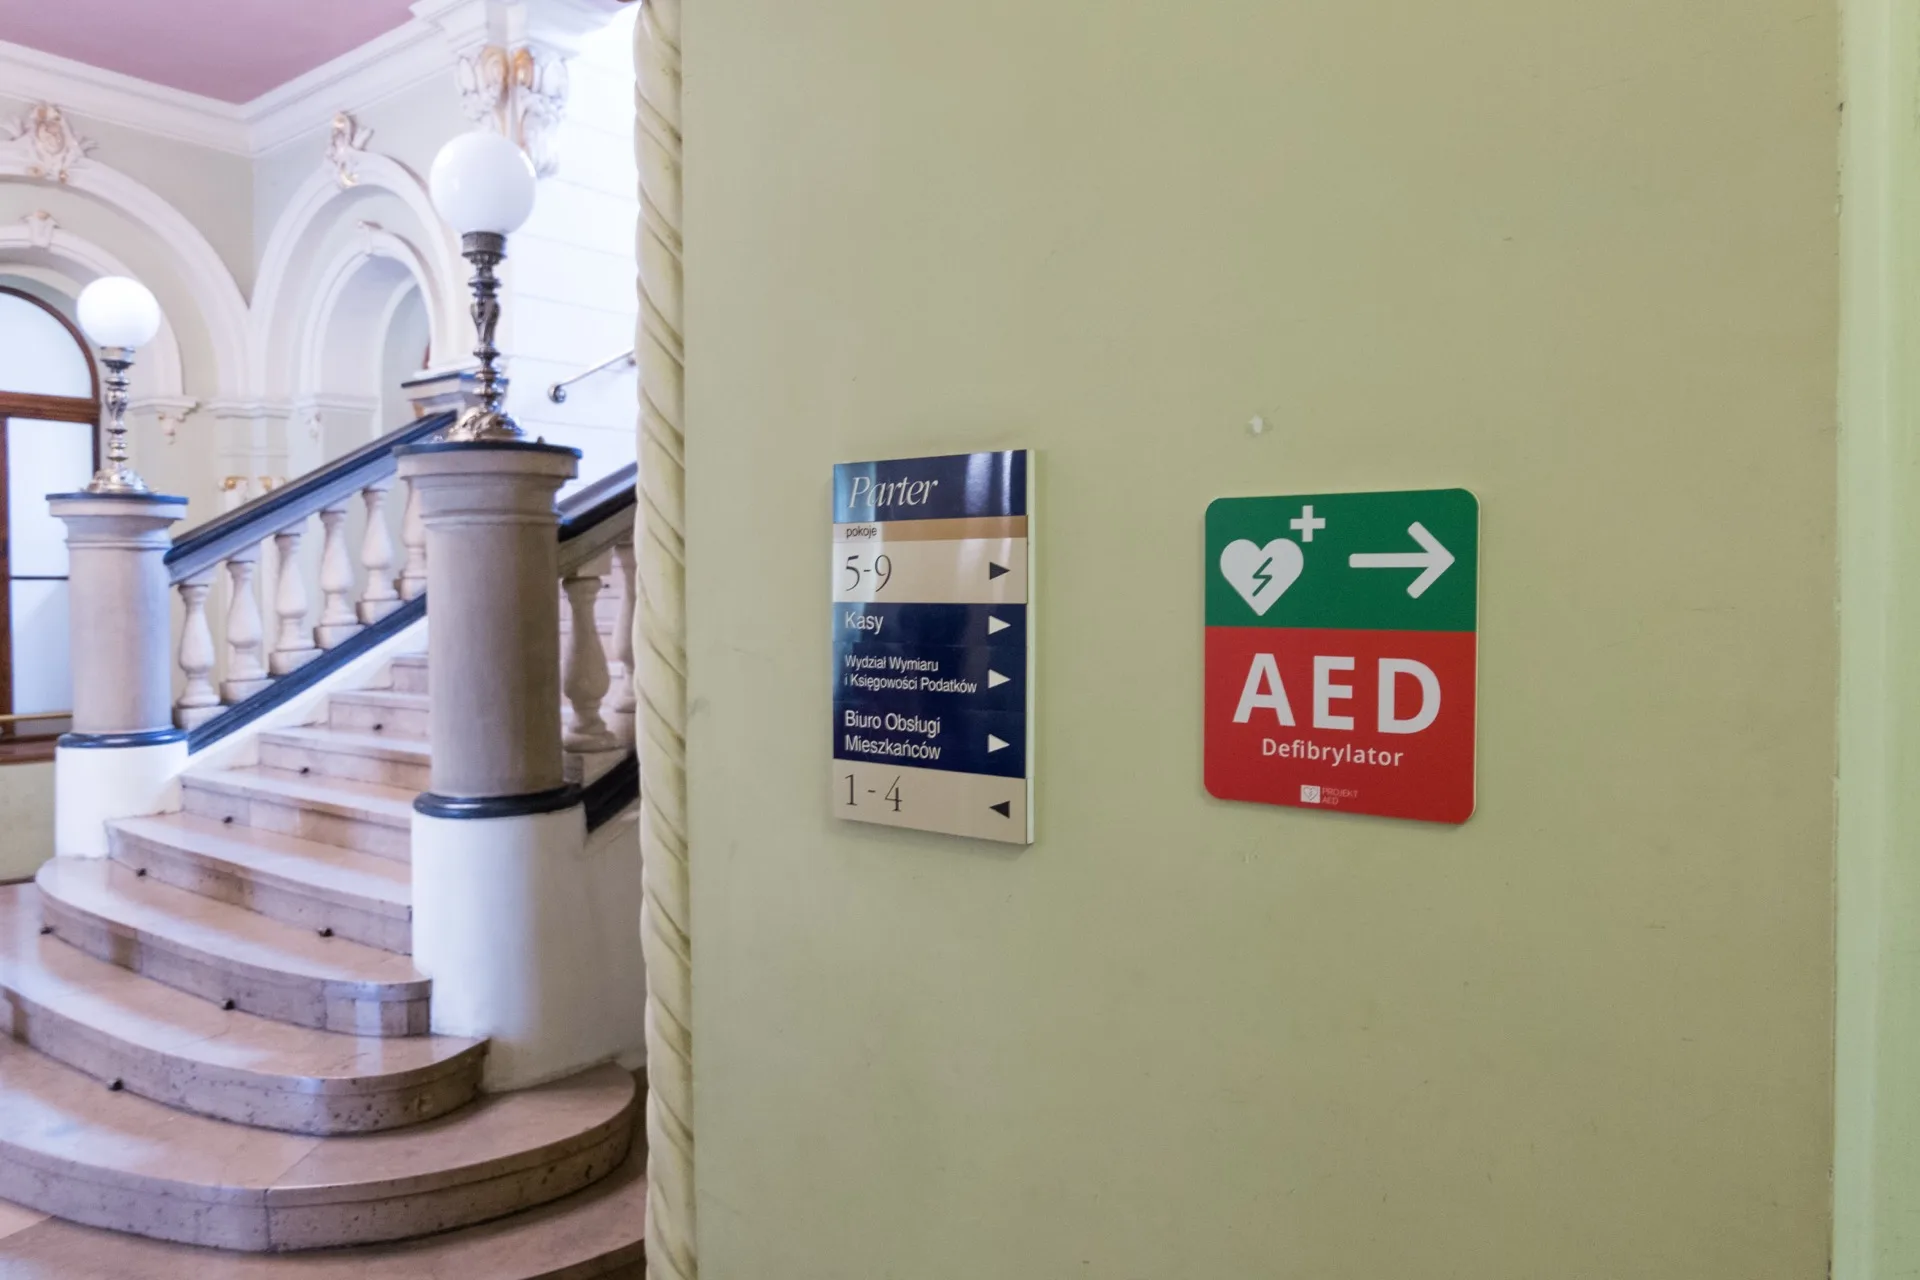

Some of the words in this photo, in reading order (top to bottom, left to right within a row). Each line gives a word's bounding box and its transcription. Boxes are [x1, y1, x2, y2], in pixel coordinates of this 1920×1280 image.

[847, 476, 938, 508] Parter
[846, 526, 877, 539] pokoje
[845, 554, 892, 593] 5-9
[845, 611, 884, 635] Kasy
[845, 654, 886, 671] Wydział
[890, 656, 939, 673] Wymiaru
[844, 674, 848, 686] i
[851, 673, 918, 691] Księgowości
[920, 676, 978, 693] Podatków
[1232, 652, 1442, 735] AED
[845, 710, 882, 729] Biuro
[885, 712, 941, 738] Obsługi
[845, 734, 941, 760] Mieszkańców
[1262, 738, 1404, 767] Defibrylator
[1322, 787, 1358, 798] PROJEKT
[1322, 795, 1339, 805] AED
